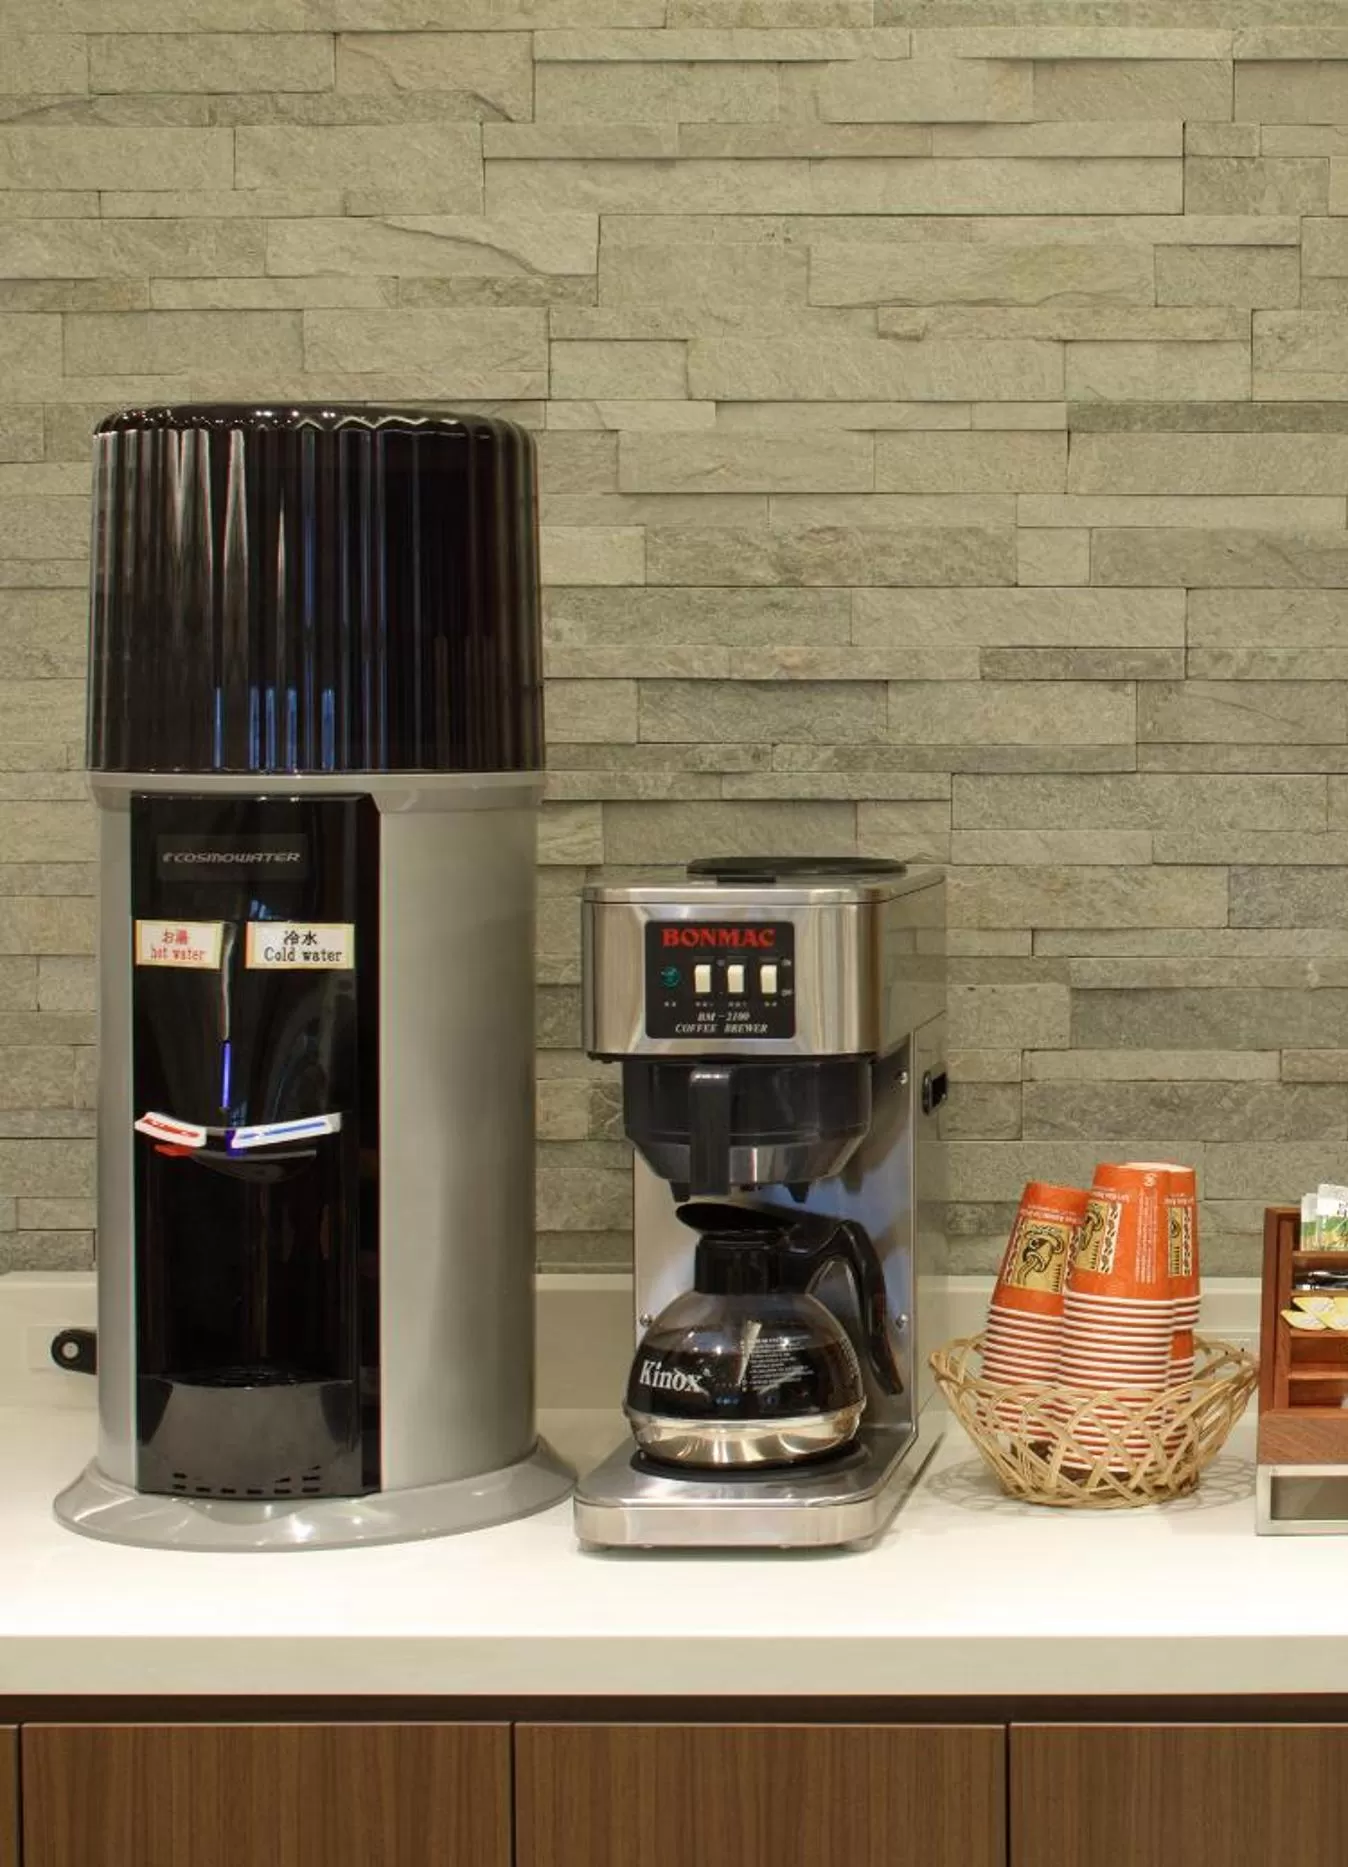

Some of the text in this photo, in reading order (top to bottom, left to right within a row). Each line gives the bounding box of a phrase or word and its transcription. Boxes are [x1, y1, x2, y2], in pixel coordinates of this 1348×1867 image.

[284, 930, 318, 945] 冷水
[661, 928, 777, 948] BONMAC
[172, 948, 206, 961] water
[264, 946, 342, 962] Cold water
[675, 1023, 769, 1034] COFFEE BREWER
[639, 1358, 709, 1397] Kinox
